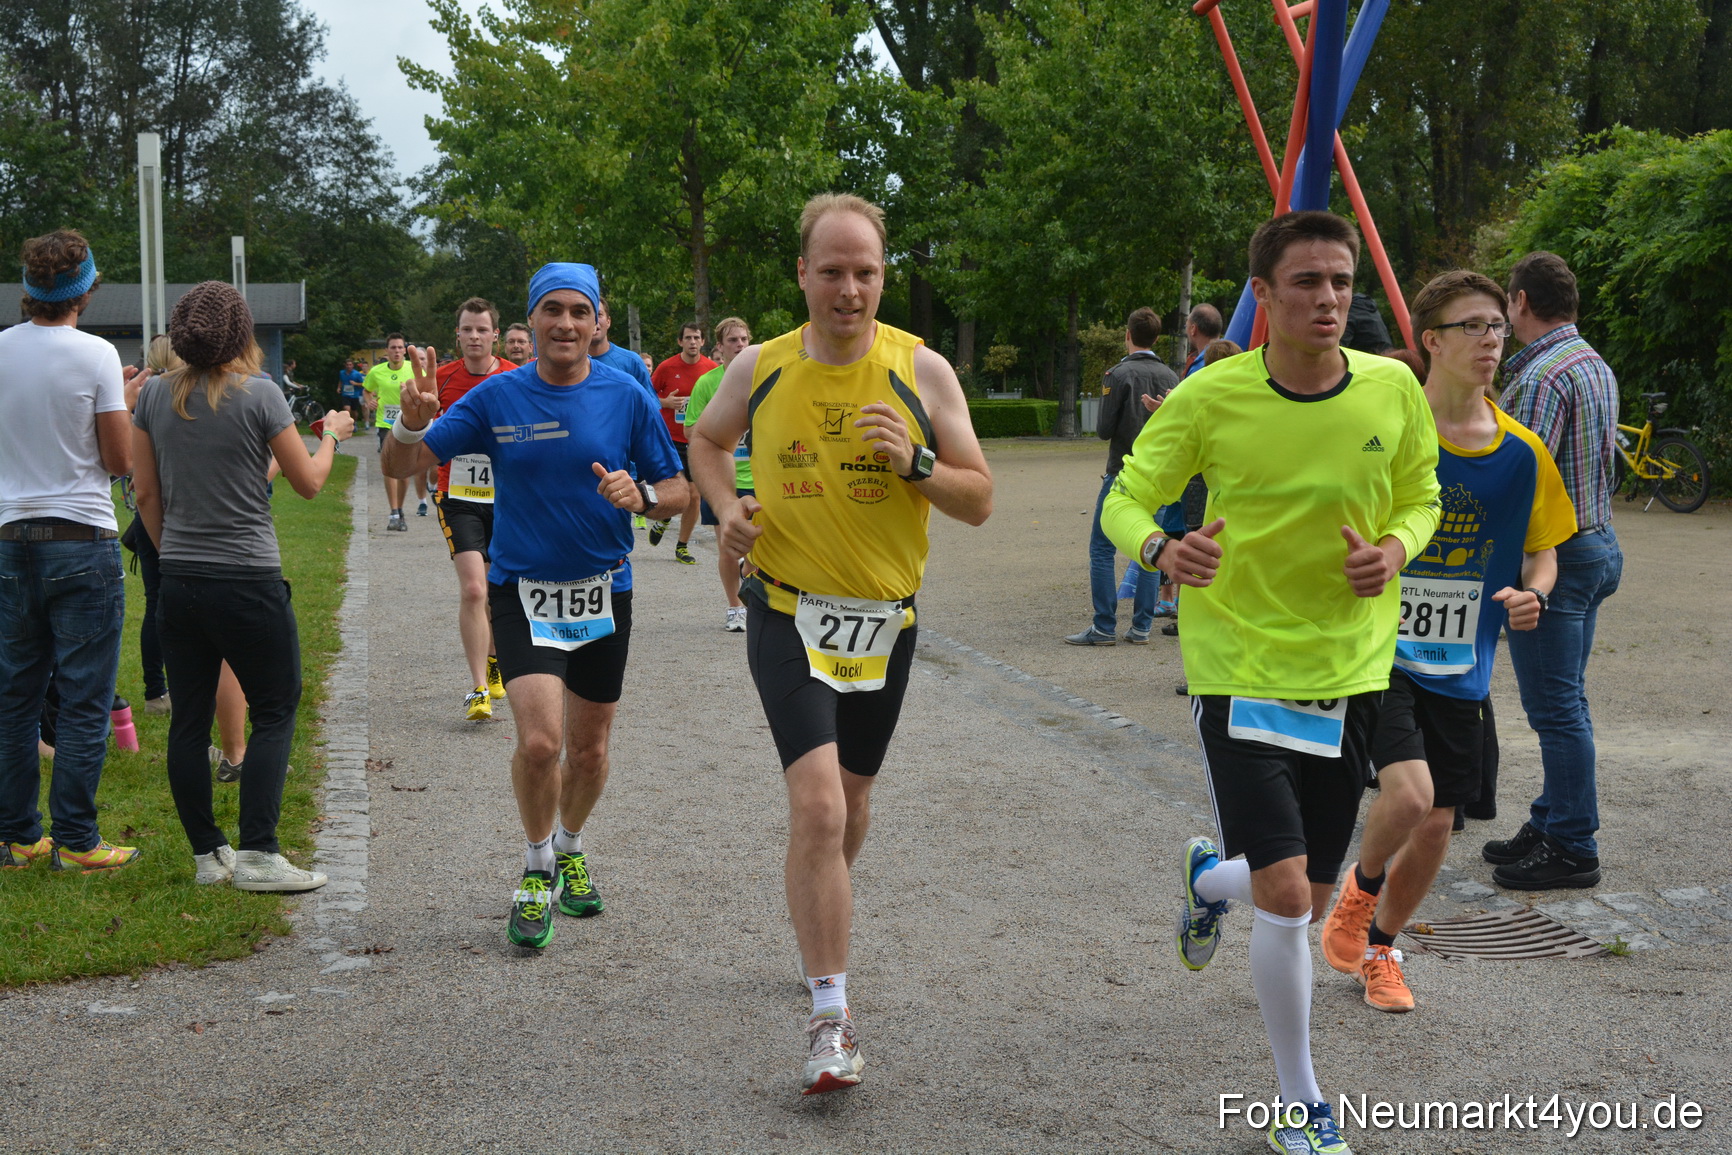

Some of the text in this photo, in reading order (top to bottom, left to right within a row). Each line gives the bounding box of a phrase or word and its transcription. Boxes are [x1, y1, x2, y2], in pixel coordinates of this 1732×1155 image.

[819, 435, 851, 443] NEUMARKT
[776, 452, 818, 464] NEUMARKTER
[468, 466, 490, 484] 14
[782, 480, 824, 495] M & S
[848, 478, 888, 490] PIZZERIA
[464, 488, 490, 496] Florian
[854, 488, 884, 498] ELIO
[1422, 588, 1465, 598] Neumarkt
[530, 586, 604, 618] 2159
[800, 597, 838, 610] PARTL
[1398, 600, 1468, 638] 2811
[551, 626, 590, 639] Robert
[818, 614, 886, 652] 277
[1413, 646, 1448, 661] Jannik
[832, 662, 862, 678] Jockl
